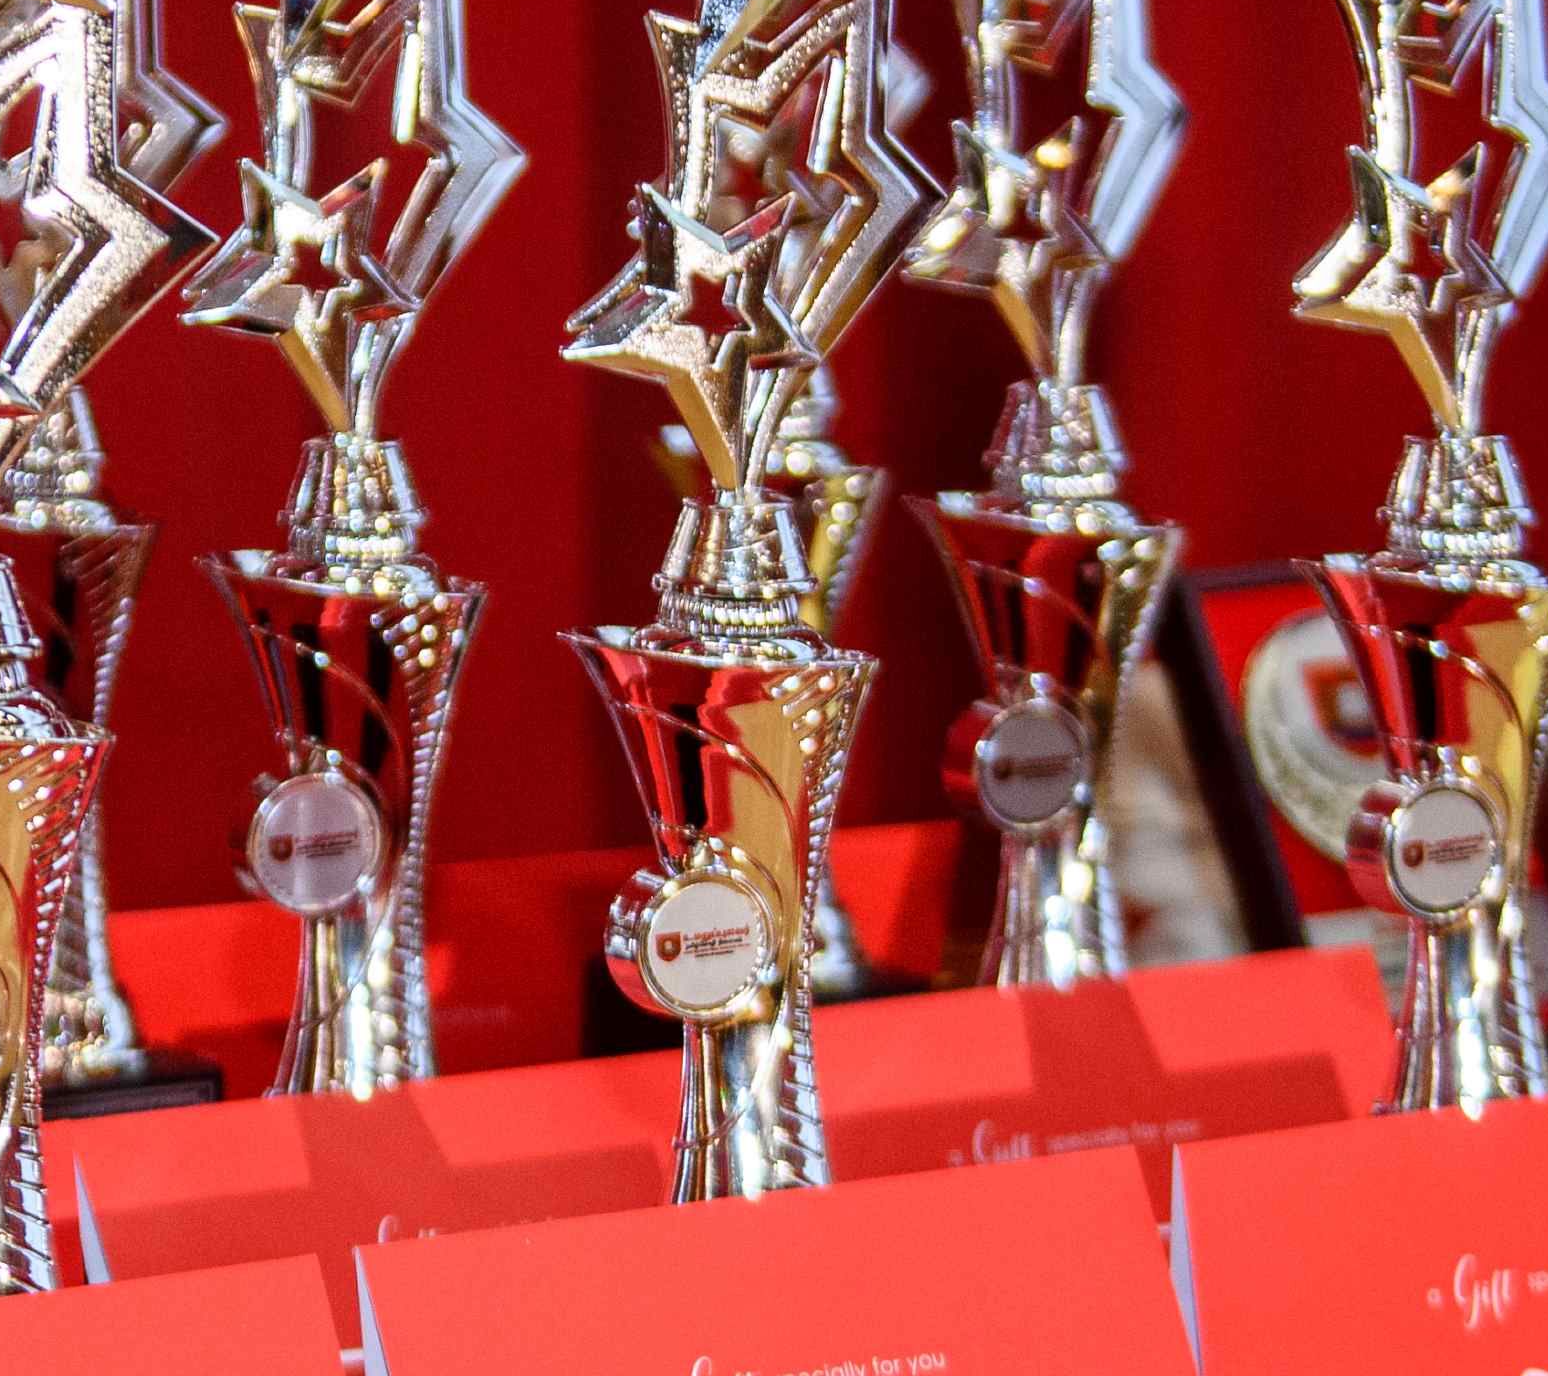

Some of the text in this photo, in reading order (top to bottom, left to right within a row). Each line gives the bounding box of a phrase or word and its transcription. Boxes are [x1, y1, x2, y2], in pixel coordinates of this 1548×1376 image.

[1453, 1252, 1513, 1331] Gift
[872, 1355, 902, 1376] for
[906, 1351, 947, 1376] you
